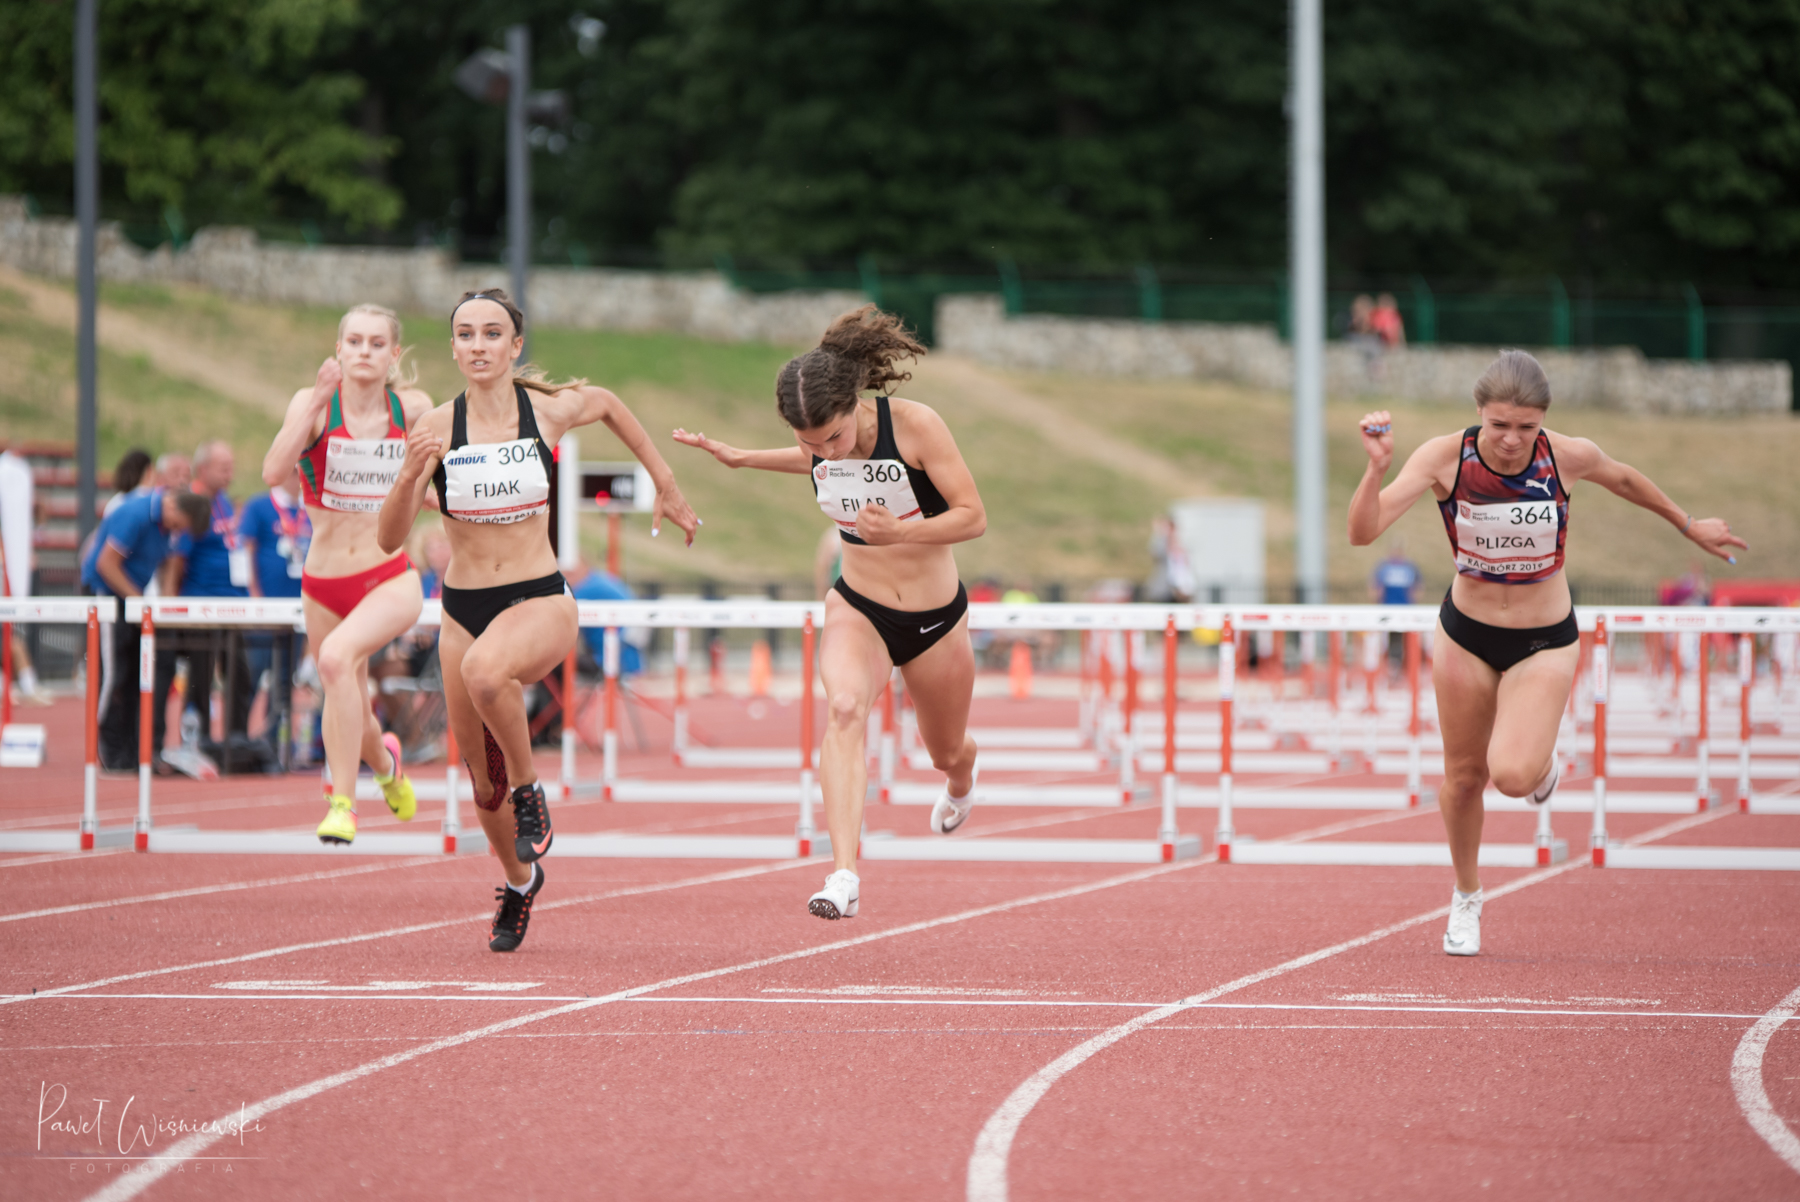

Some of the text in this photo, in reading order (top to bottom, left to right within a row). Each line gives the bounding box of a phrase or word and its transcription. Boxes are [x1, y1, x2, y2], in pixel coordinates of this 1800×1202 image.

[374, 444, 405, 460] 410
[498, 443, 538, 465] 304
[863, 464, 901, 482] 360
[473, 479, 521, 498] FIJAK
[1510, 506, 1552, 524] 364
[1476, 536, 1536, 549] PLIZGA
[1467, 557, 1516, 572] RACIBÓRZ
[1519, 562, 1543, 572] 2019
